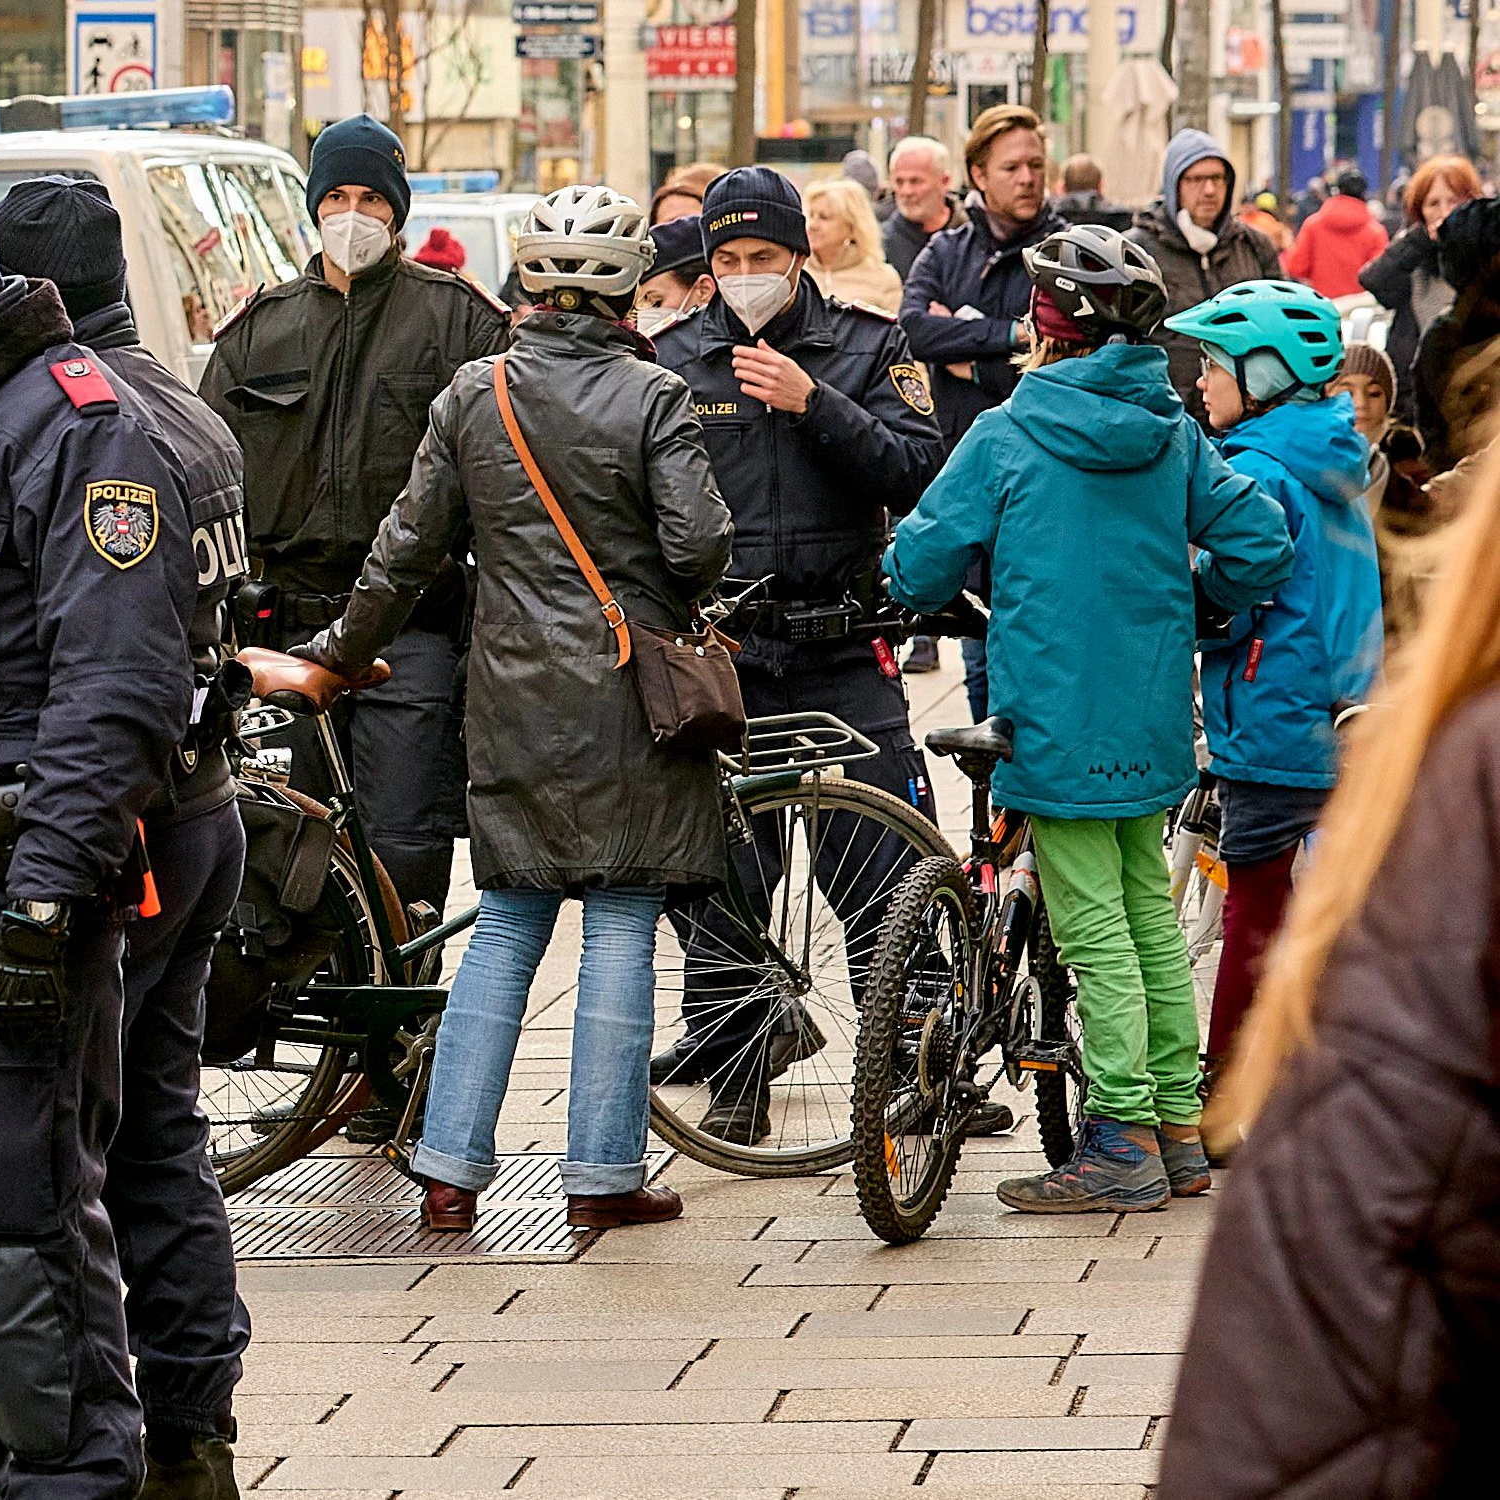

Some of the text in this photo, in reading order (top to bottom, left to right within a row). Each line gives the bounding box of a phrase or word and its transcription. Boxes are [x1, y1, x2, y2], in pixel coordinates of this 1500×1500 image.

[709, 212, 741, 233] POLIZEI
[695, 402, 737, 416] OLIZEI
[92, 486, 152, 505] POLIZEI
